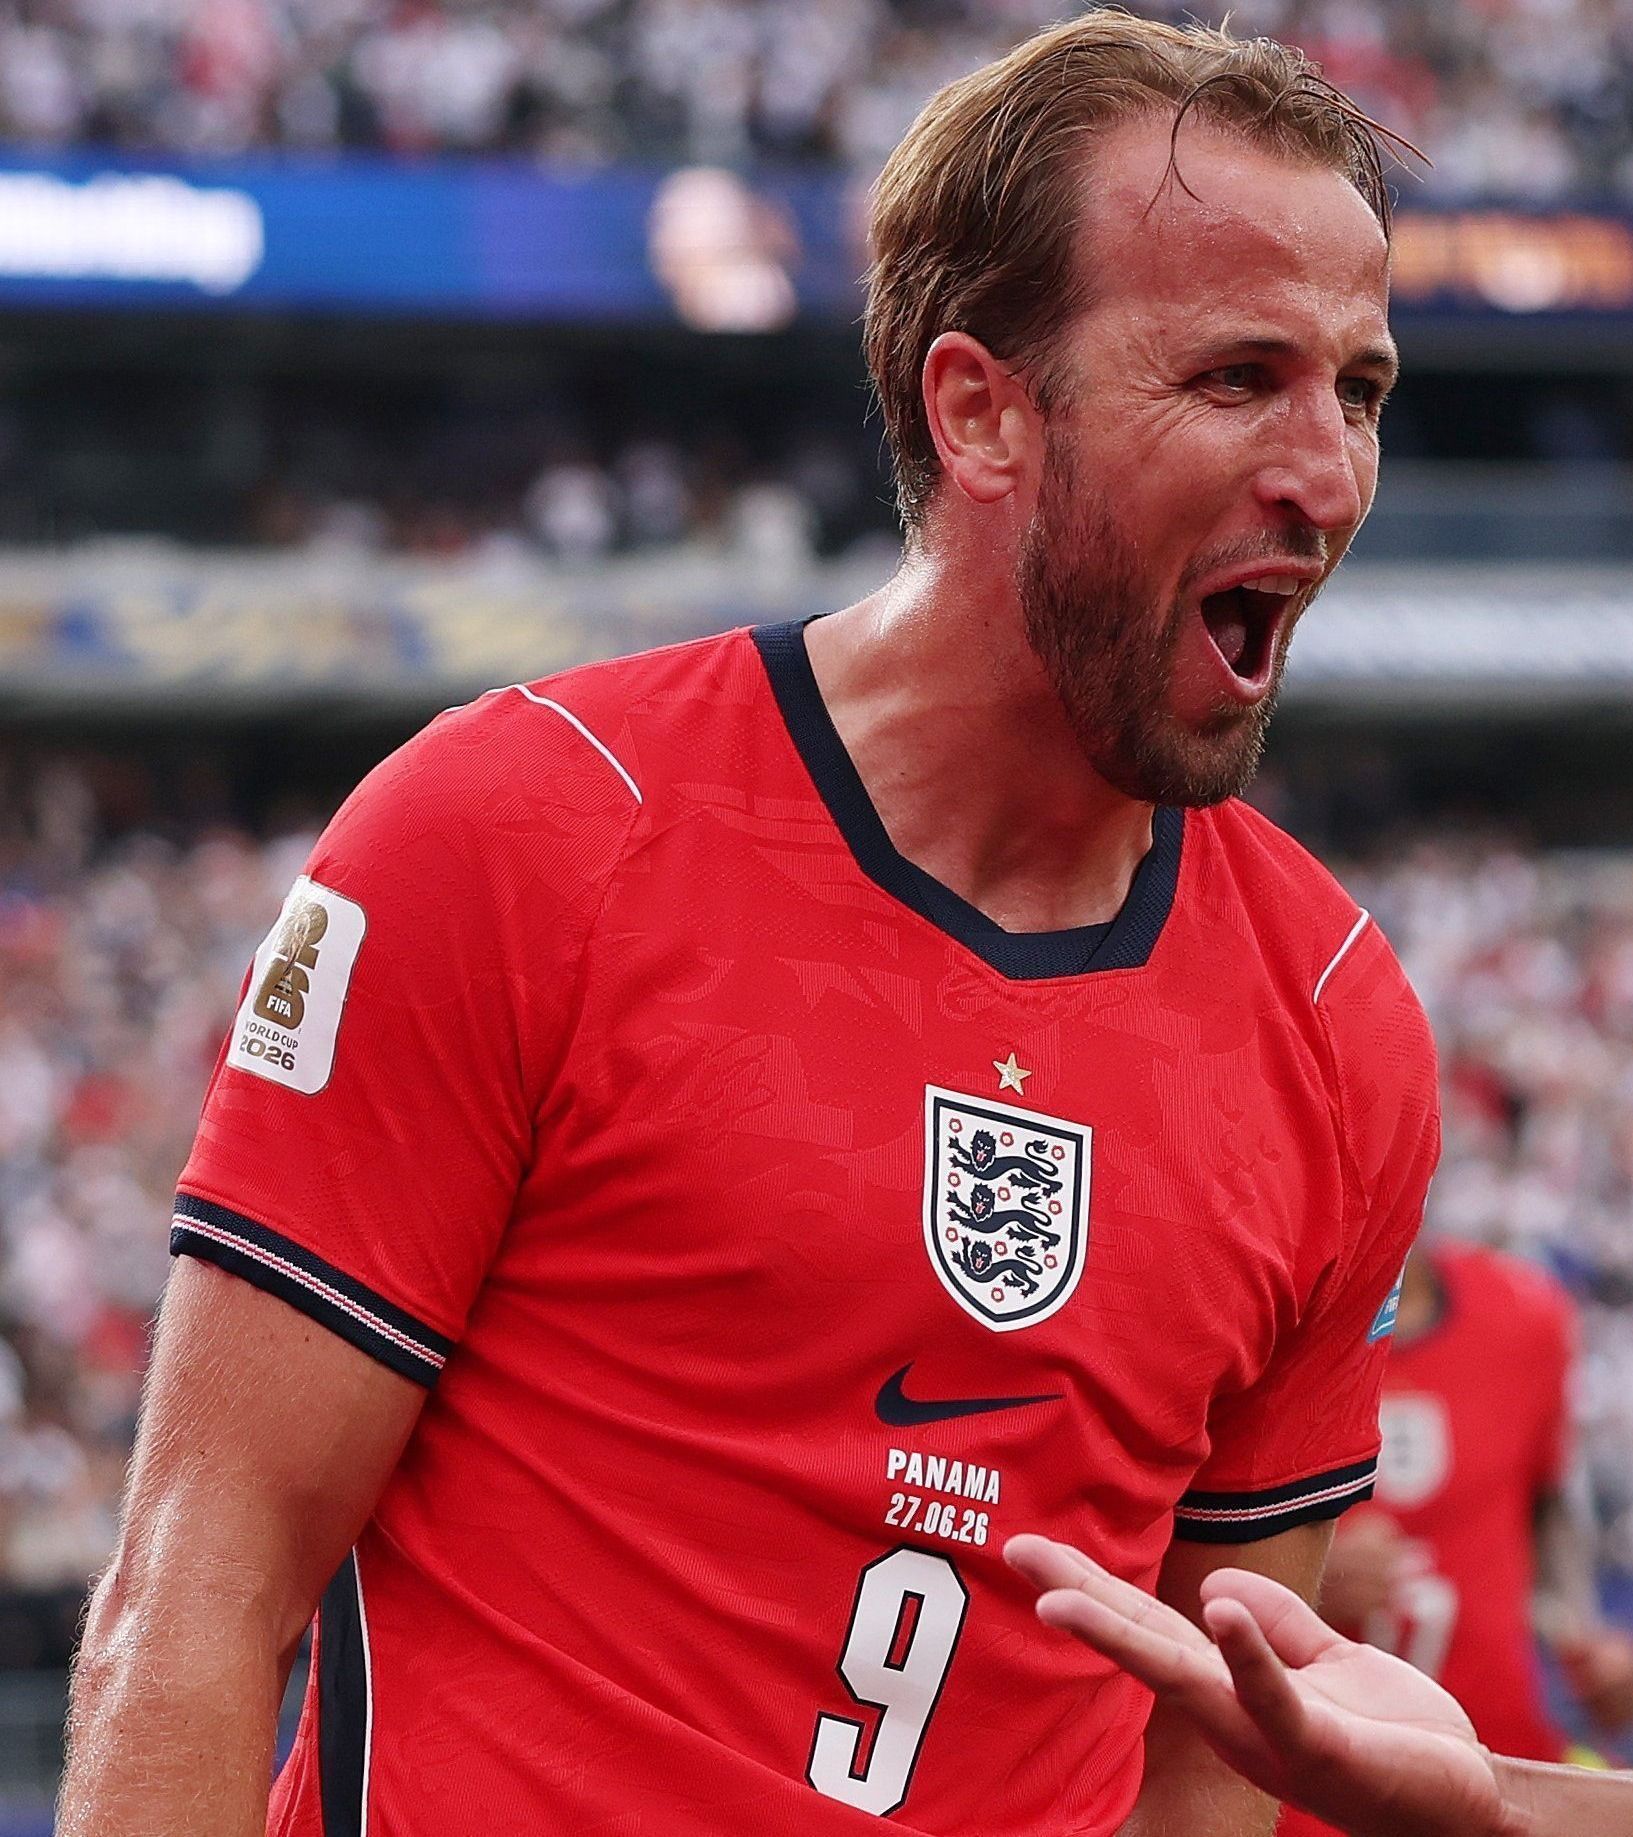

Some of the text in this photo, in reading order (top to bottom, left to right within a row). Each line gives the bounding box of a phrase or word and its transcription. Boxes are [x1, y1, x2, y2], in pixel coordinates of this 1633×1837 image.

[266, 995, 292, 1018] FIFA
[239, 1034, 295, 1071] 2026
[281, 1034, 299, 1050] CUP
[887, 1448, 1001, 1504] PANAMA
[884, 1492, 989, 1546] 27.06.26
[804, 1543, 970, 1818] 9
